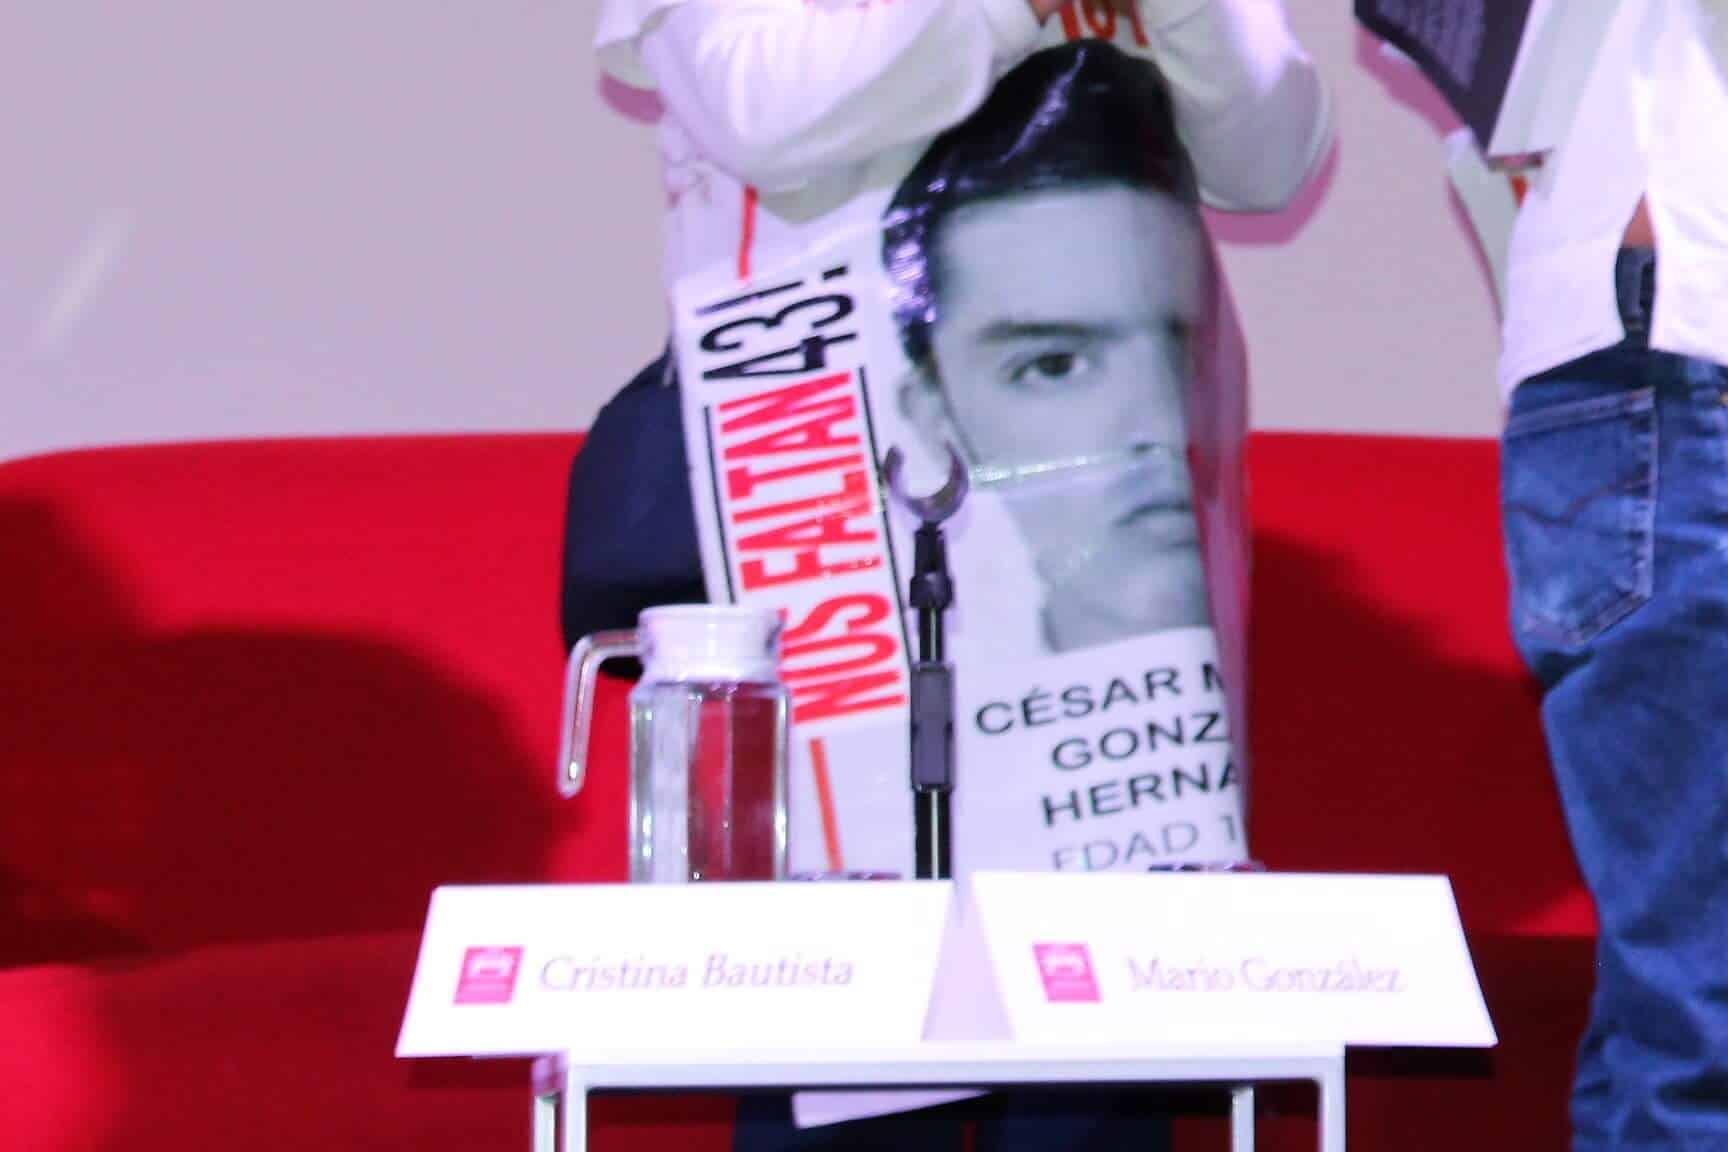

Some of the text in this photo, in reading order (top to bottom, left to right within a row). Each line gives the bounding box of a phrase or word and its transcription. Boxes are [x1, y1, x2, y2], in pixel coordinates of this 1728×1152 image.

[696, 264, 858, 381] 43!
[719, 370, 882, 593] FALTAN
[975, 666, 1183, 736] CÉSAR
[537, 952, 855, 991] Cristina Bautista
[1124, 954, 1234, 993] Mario
